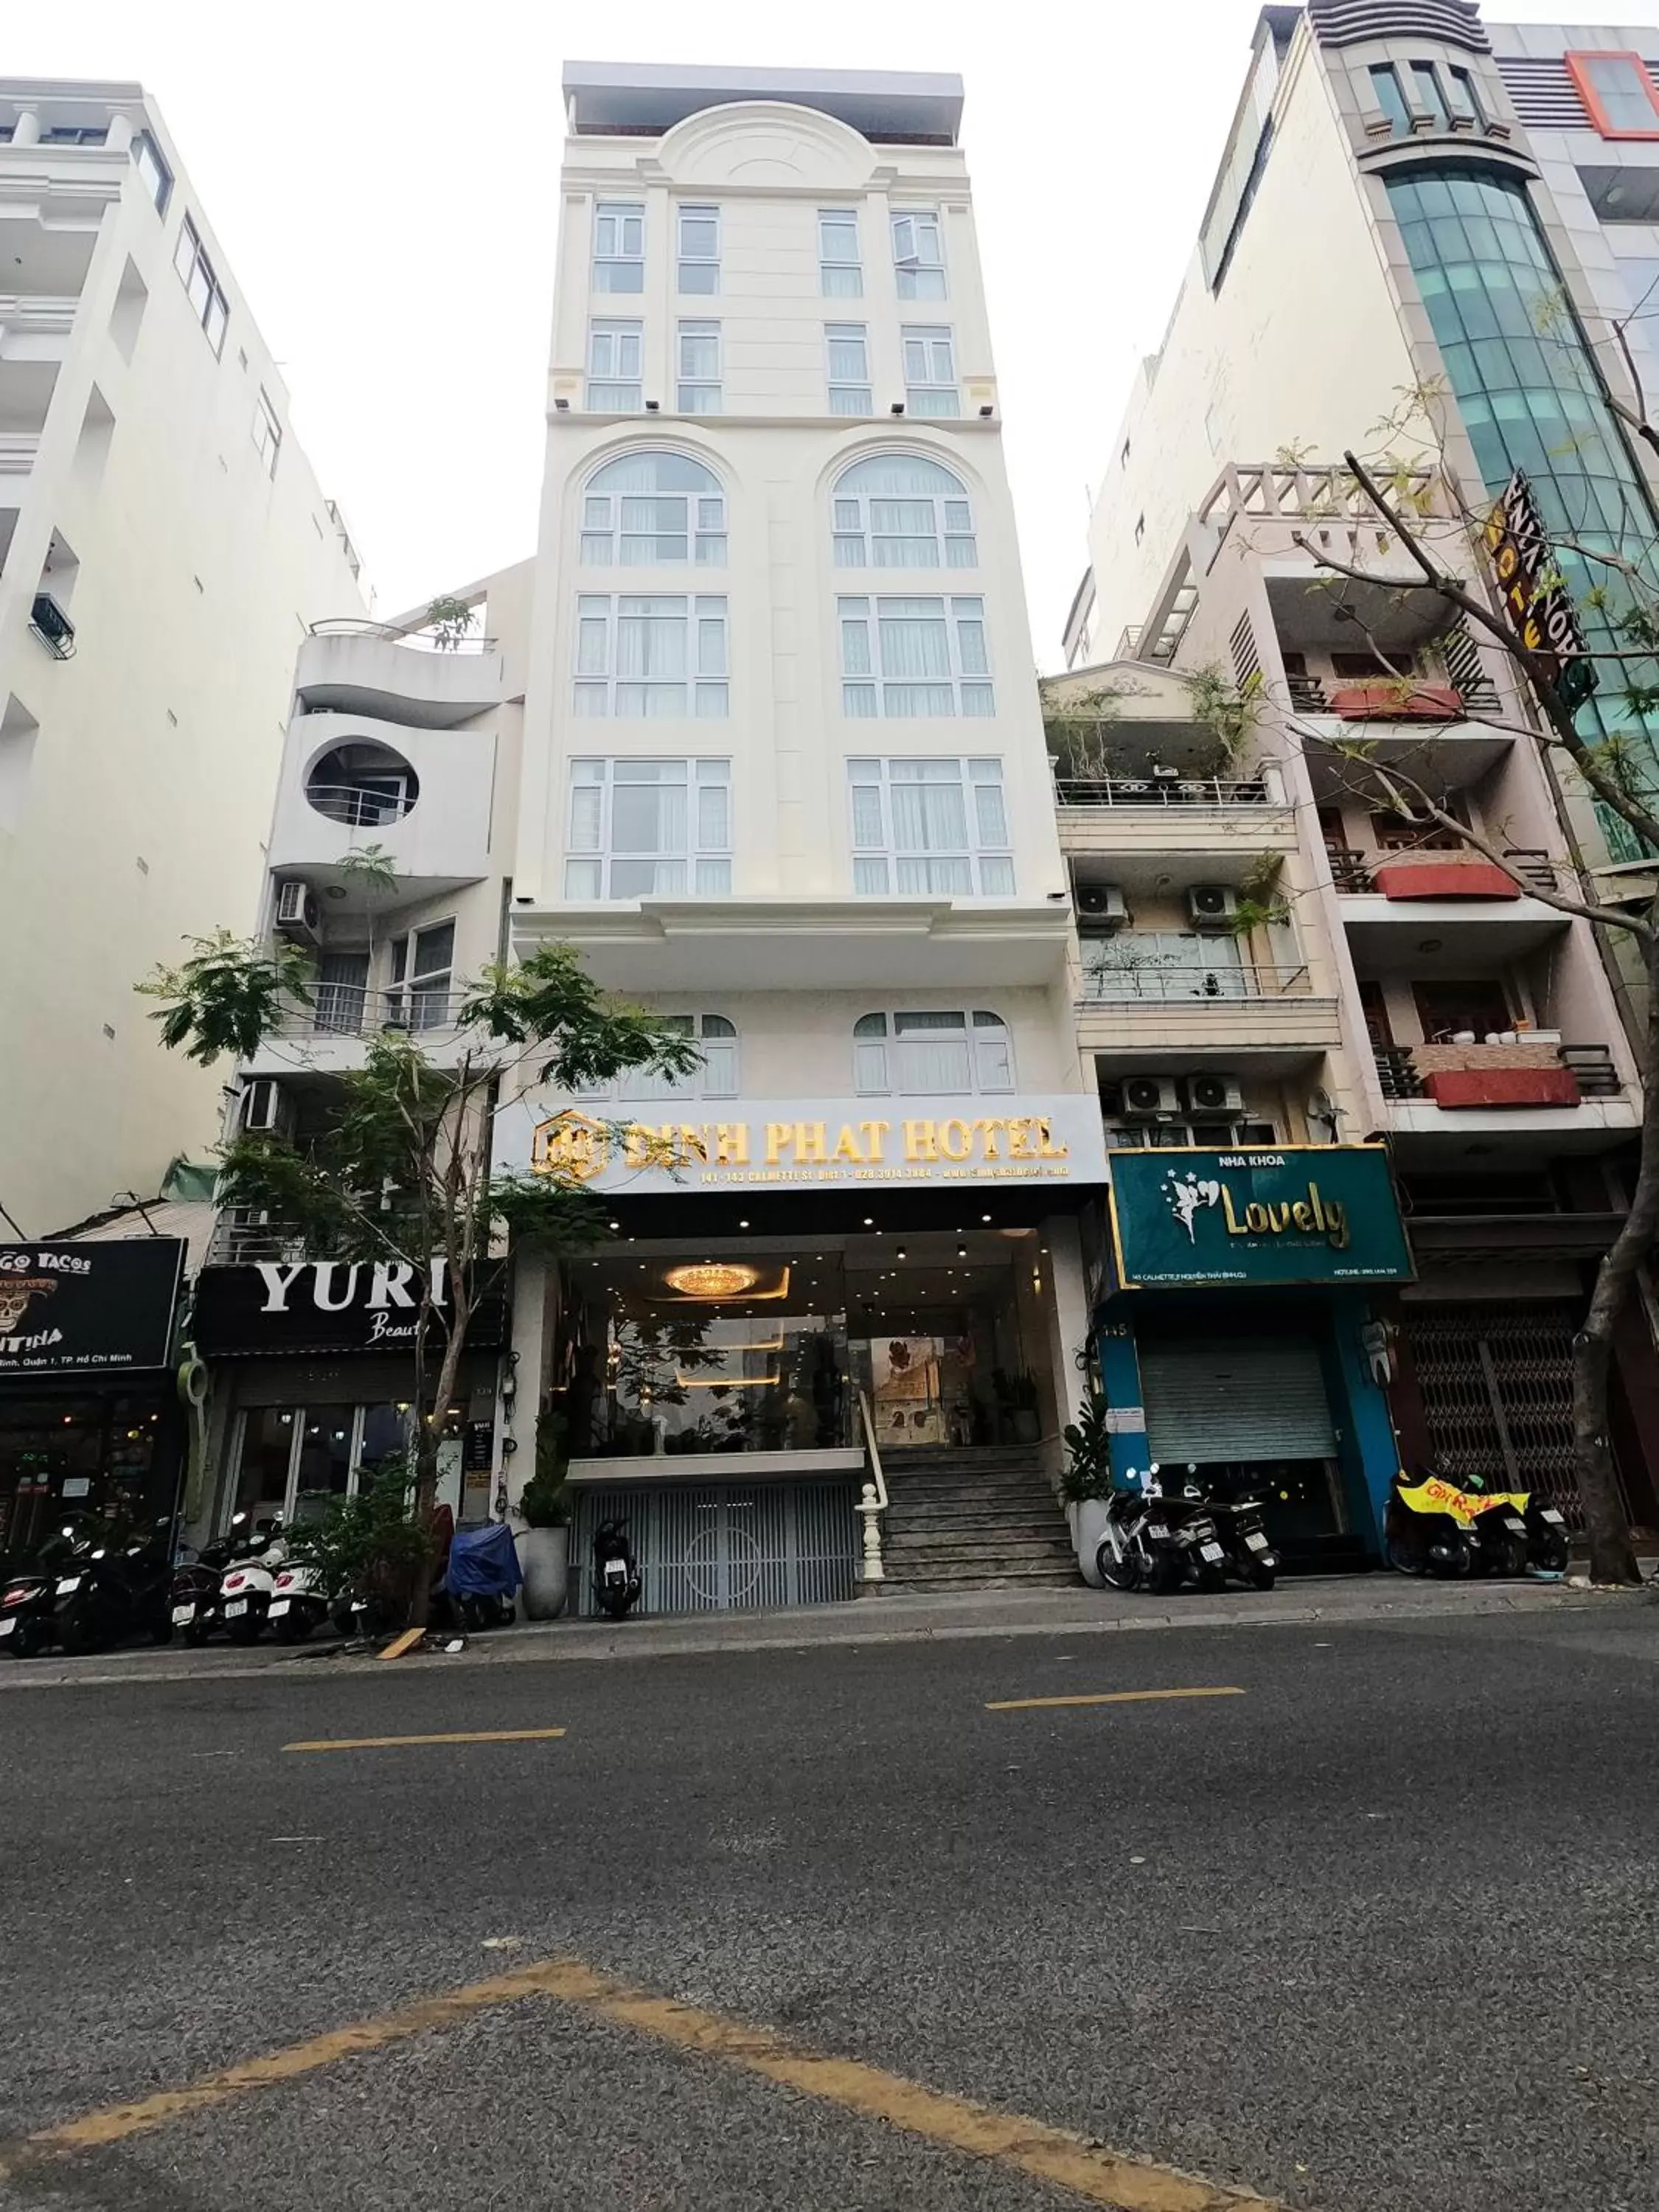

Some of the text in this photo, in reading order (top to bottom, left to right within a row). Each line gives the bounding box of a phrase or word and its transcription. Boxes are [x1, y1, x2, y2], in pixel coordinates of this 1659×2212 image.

[625, 1116, 1069, 1168] DINH PHAT HOTEL
[1218, 1155, 1286, 1168] NHA KHOA
[1220, 1182, 1349, 1249] Lovely
[38, 1252, 92, 1275] TACOS
[254, 1256, 449, 1312] YURI
[109, 1352, 133, 1363] Minh
